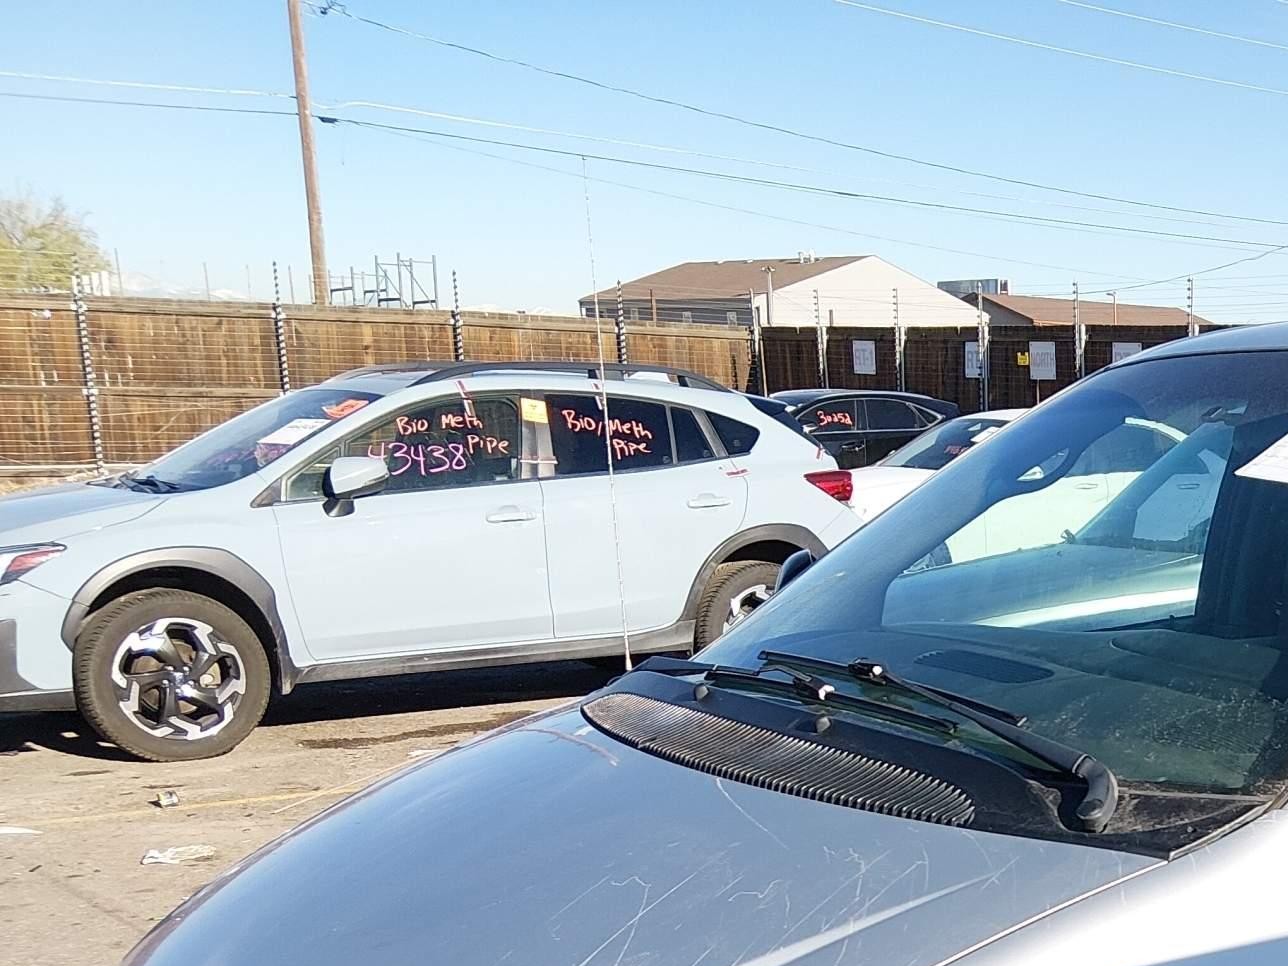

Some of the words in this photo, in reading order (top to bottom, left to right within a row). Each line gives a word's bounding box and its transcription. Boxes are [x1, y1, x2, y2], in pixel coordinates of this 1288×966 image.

[1030, 351, 1055, 369] NORTH
[395, 415, 429, 436] Bio
[440, 411, 484, 430] Meth
[608, 418, 653, 440] Meth
[466, 433, 510, 455] Pipe
[612, 438, 653, 461] Pipe
[367, 441, 467, 477] 43438
